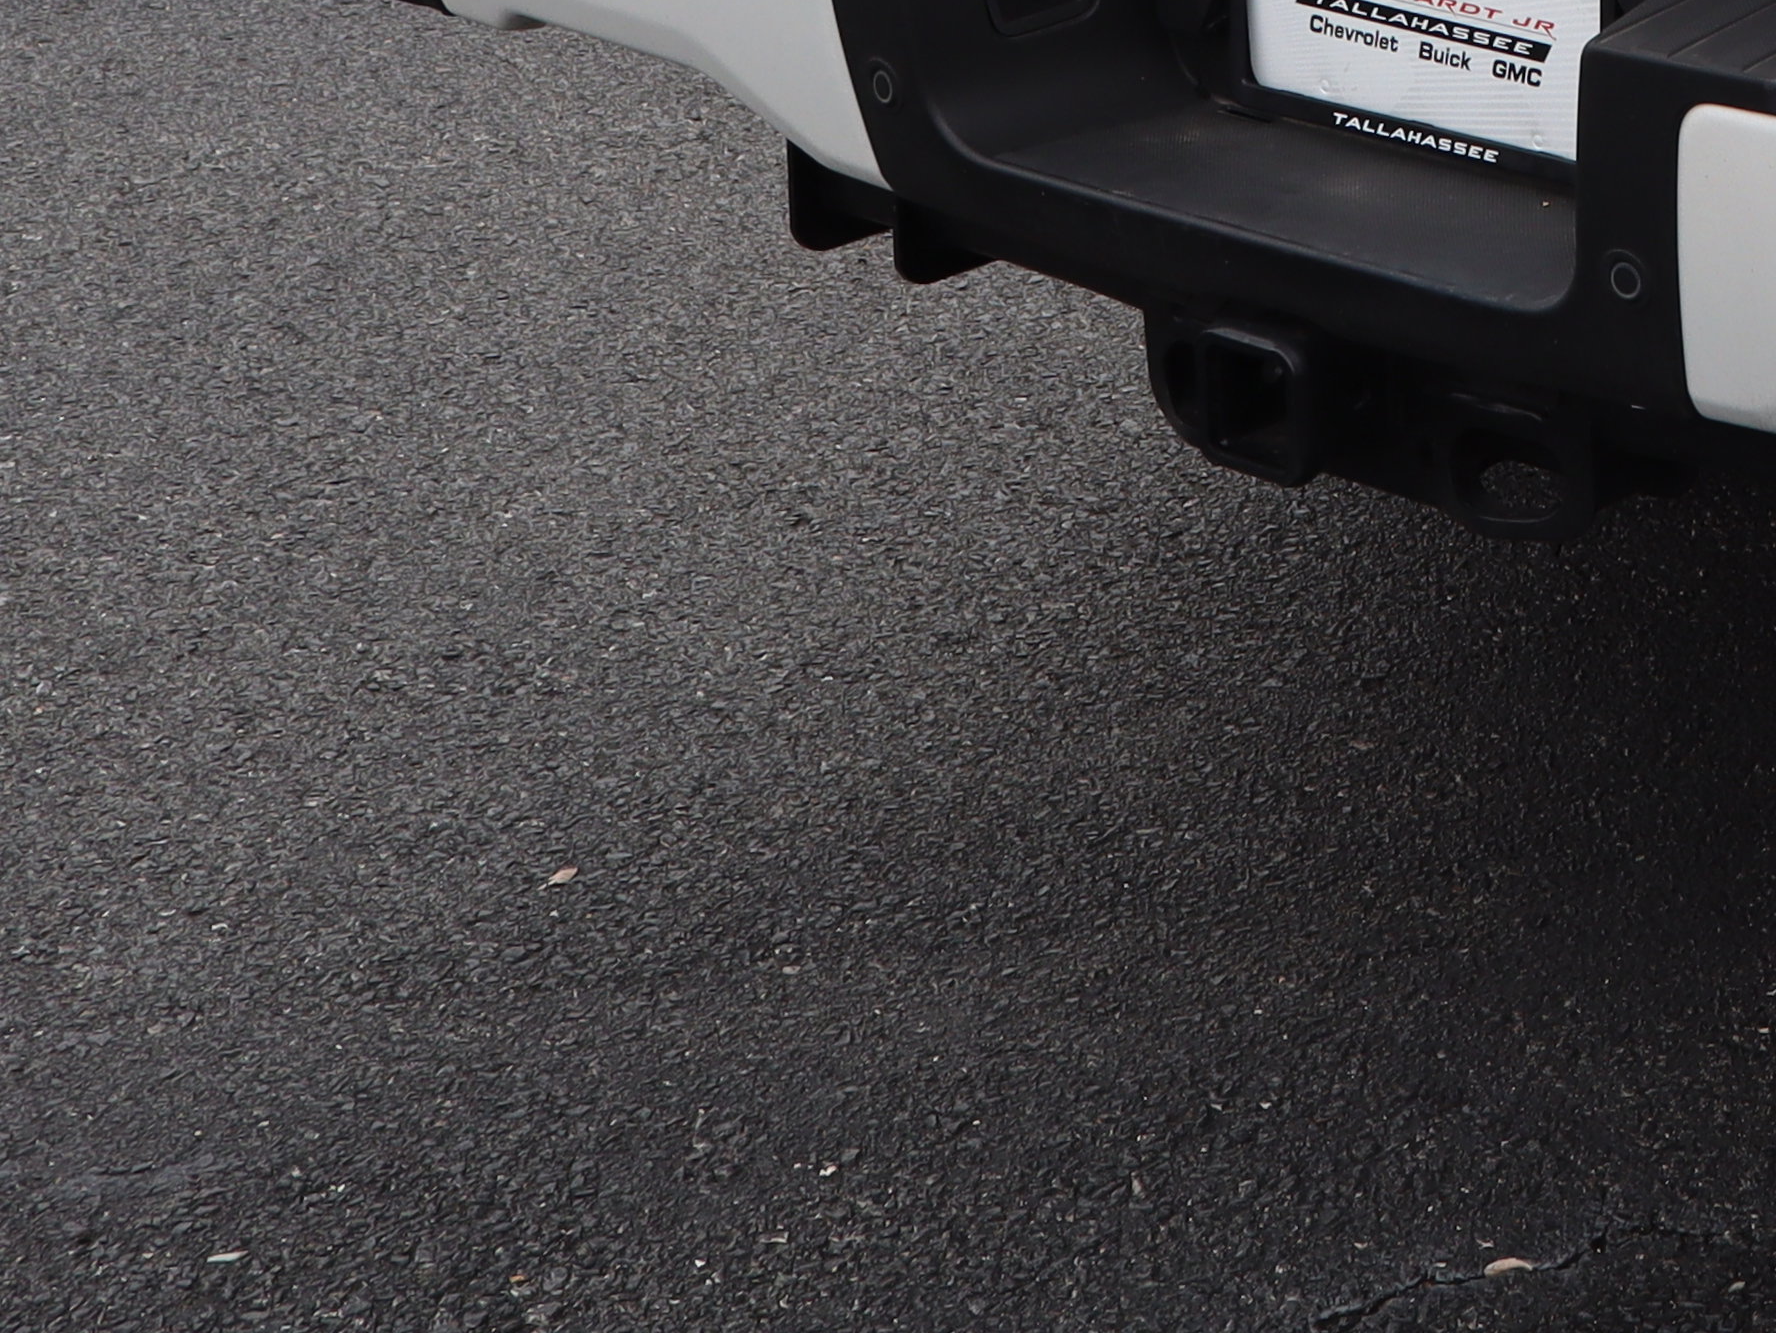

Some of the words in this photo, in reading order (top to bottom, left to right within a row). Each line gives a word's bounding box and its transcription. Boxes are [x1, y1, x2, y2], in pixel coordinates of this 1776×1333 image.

[1309, 14, 1400, 53] Chevrolet
[1418, 41, 1472, 72] Buick
[1492, 59, 1544, 87] GMC
[1511, 16, 1558, 40] JR
[1332, 112, 1500, 164] TALLAHASSEE
